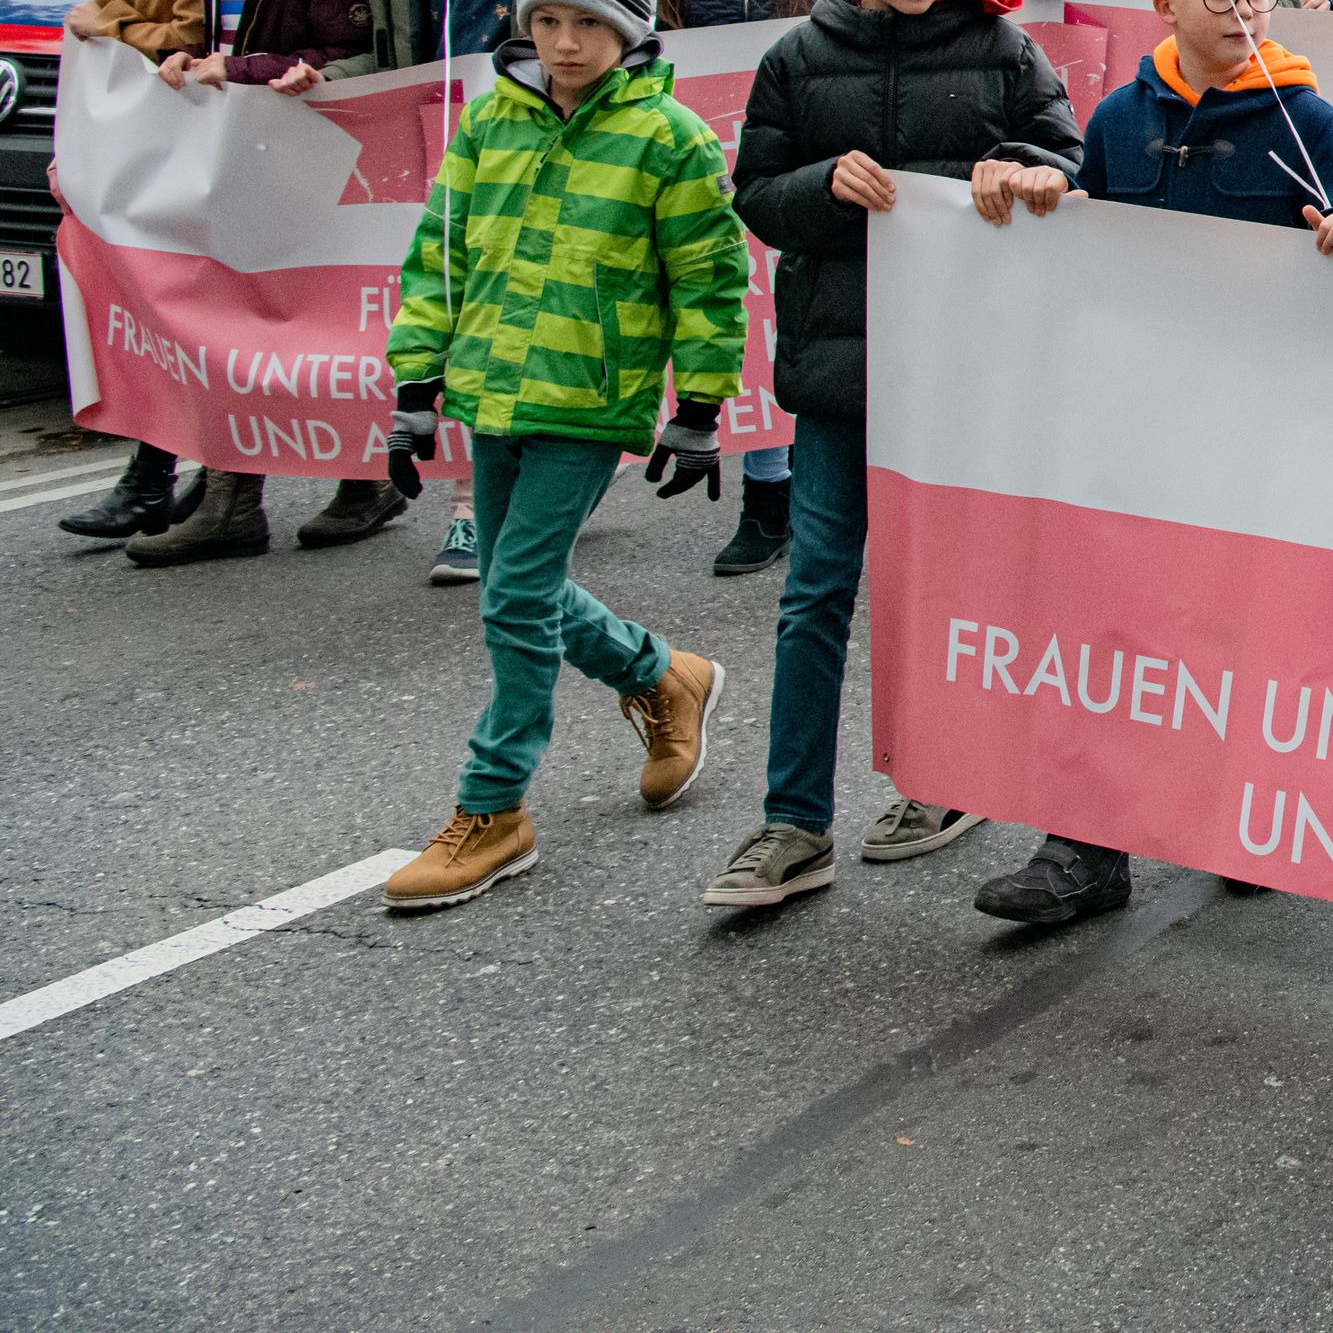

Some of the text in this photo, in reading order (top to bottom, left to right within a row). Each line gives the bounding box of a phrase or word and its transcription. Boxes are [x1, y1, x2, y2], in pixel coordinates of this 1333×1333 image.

[107, 303, 210, 391] FRAUEN
[226, 348, 399, 401] UNTER
[227, 413, 342, 461] UND
[946, 618, 1234, 742] FRAUEN
